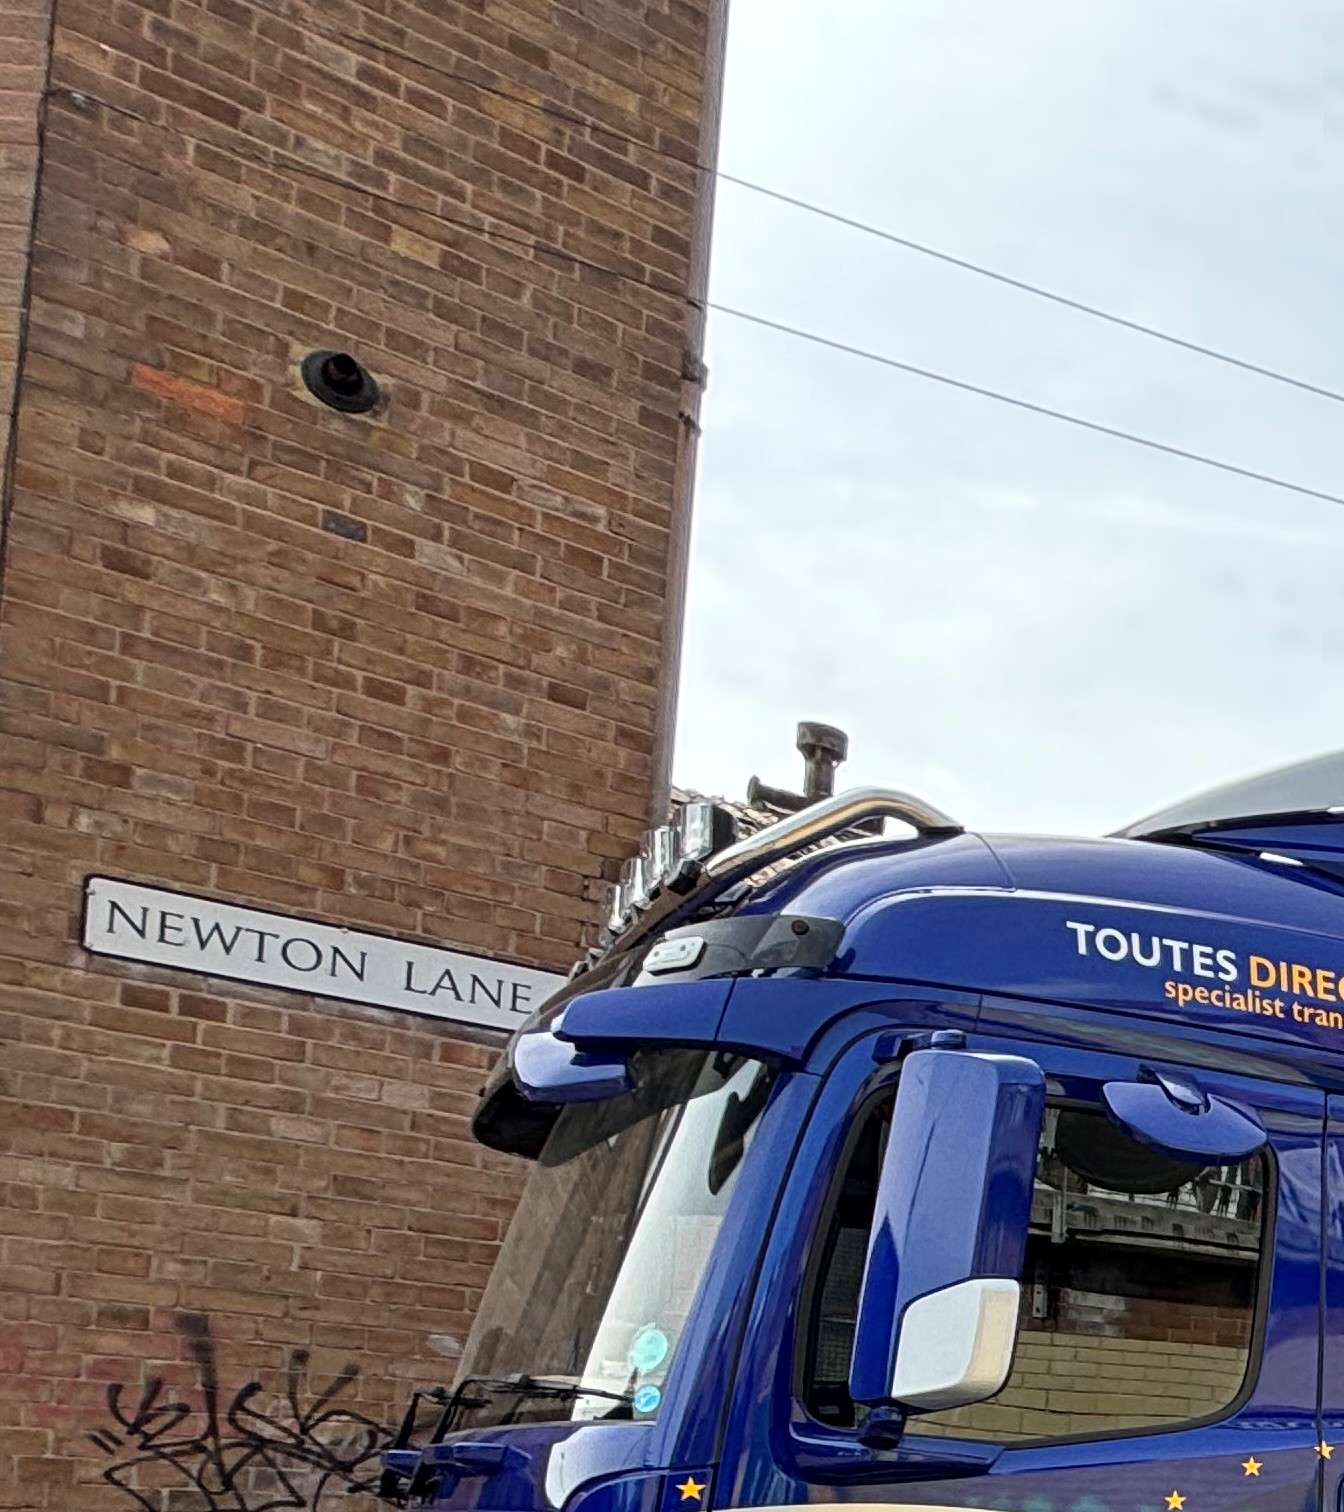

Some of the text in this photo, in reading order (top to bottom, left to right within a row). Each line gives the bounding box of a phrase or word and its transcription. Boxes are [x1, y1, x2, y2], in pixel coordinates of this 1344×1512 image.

[106, 900, 532, 1015] NEWTON LANE
[1066, 921, 1238, 982] TOUTES
[1164, 979, 1286, 1019] specialist
